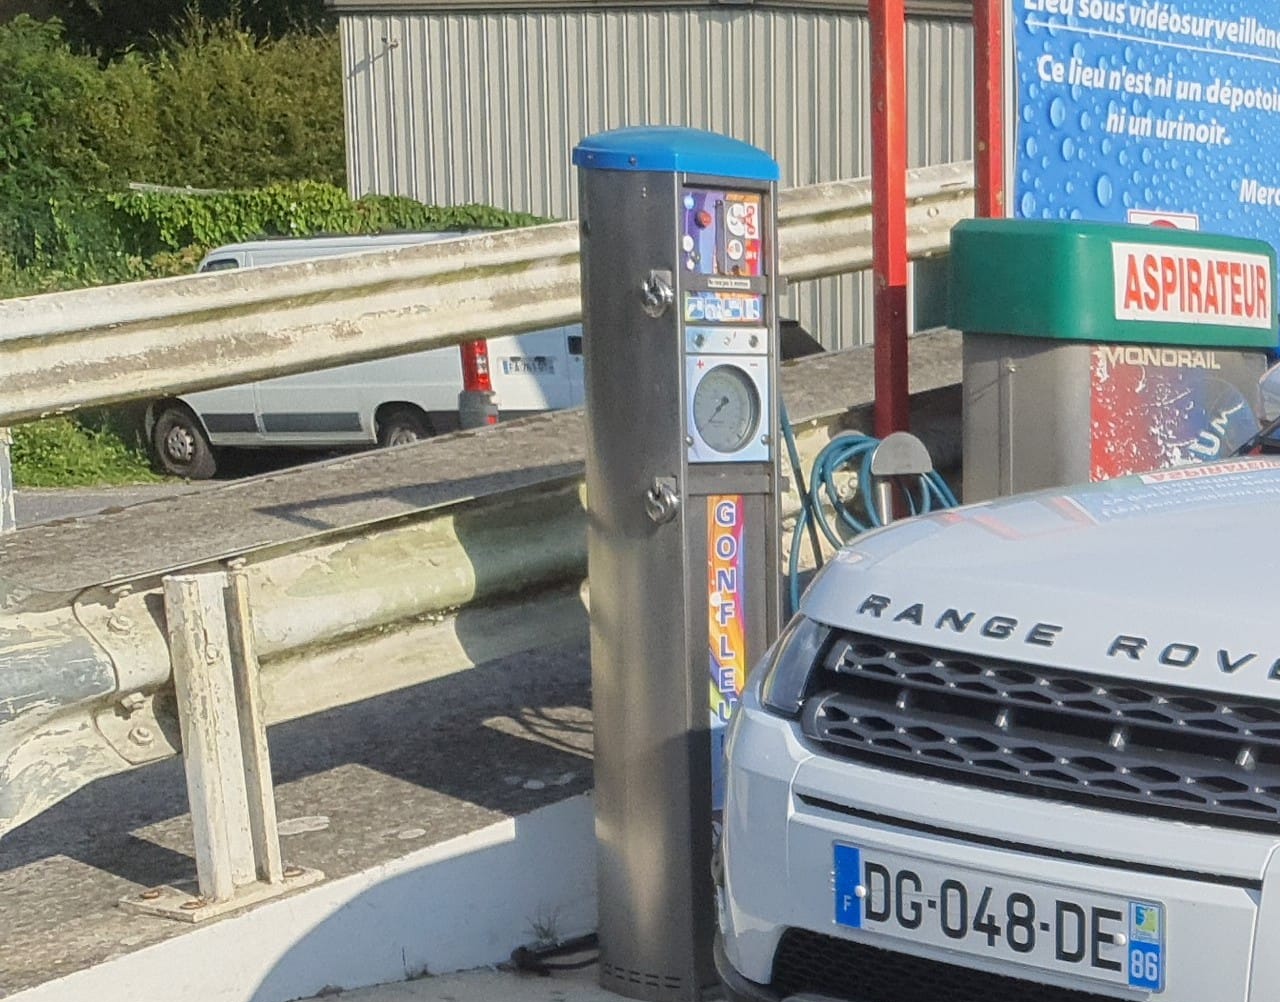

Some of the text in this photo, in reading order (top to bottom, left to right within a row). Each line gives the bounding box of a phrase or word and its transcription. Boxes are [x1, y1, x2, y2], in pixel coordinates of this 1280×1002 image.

[1079, 0, 1125, 24] sous
[1038, 54, 1065, 83] Ce
[1068, 57, 1105, 89] lieu
[1109, 65, 1152, 96] n'est
[1154, 71, 1173, 98] ni
[1176, 80, 1201, 102] un
[1106, 106, 1231, 145] ni un urinoir.
[1124, 254, 1268, 319] ASPIRATEUR
[1100, 346, 1222, 370] MONORAIL
[714, 501, 738, 756] GONFLEU
[856, 593, 1064, 648] RANGE
[843, 894, 853, 912] F
[864, 861, 1123, 972] DG-048-DE
[1131, 949, 1158, 982] 86
